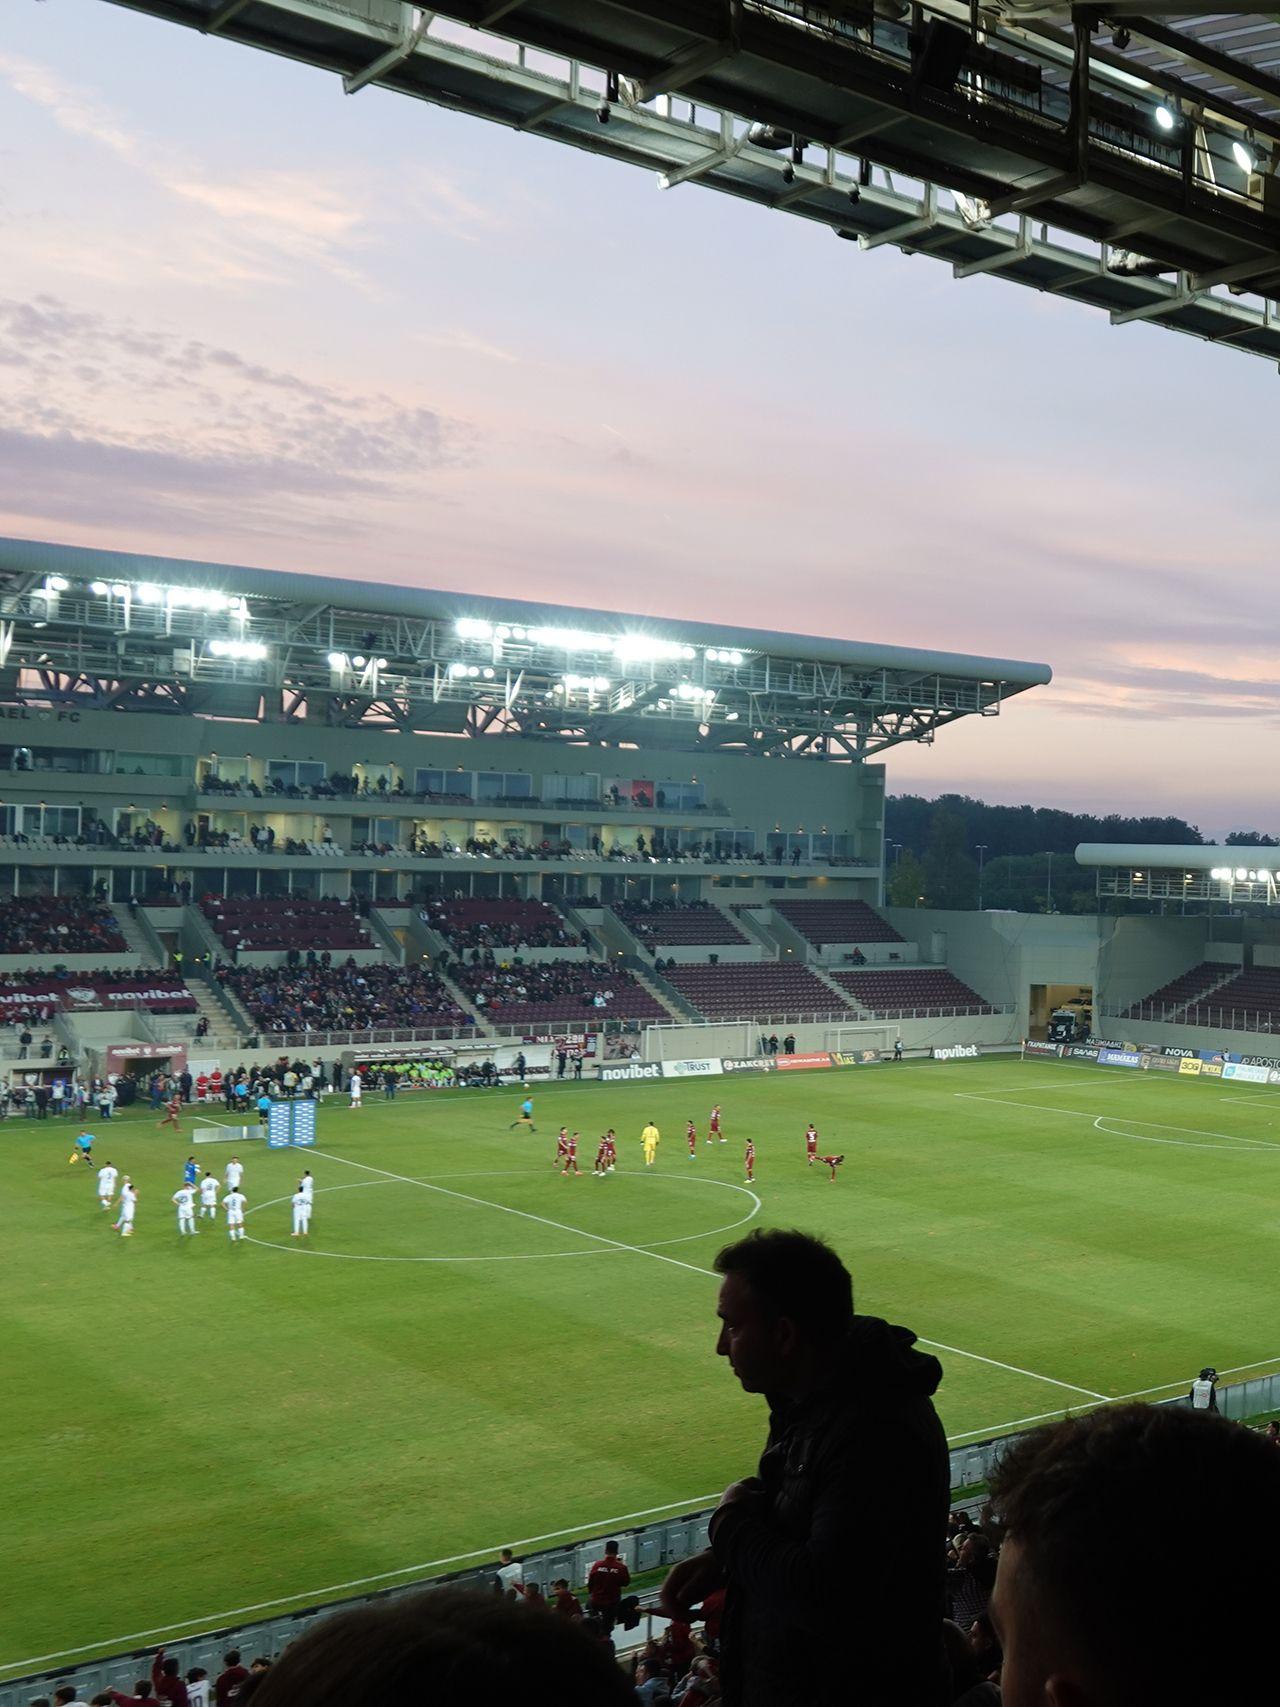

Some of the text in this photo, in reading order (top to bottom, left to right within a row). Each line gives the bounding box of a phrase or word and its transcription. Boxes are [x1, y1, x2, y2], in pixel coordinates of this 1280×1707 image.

[0, 993, 59, 1003] vibet
[108, 989, 193, 1001] novibet
[934, 1044, 978, 1060] novibet
[1165, 1047, 1194, 1058] NOVA
[602, 1063, 660, 1080] novibet
[683, 1061, 711, 1072] TRUST
